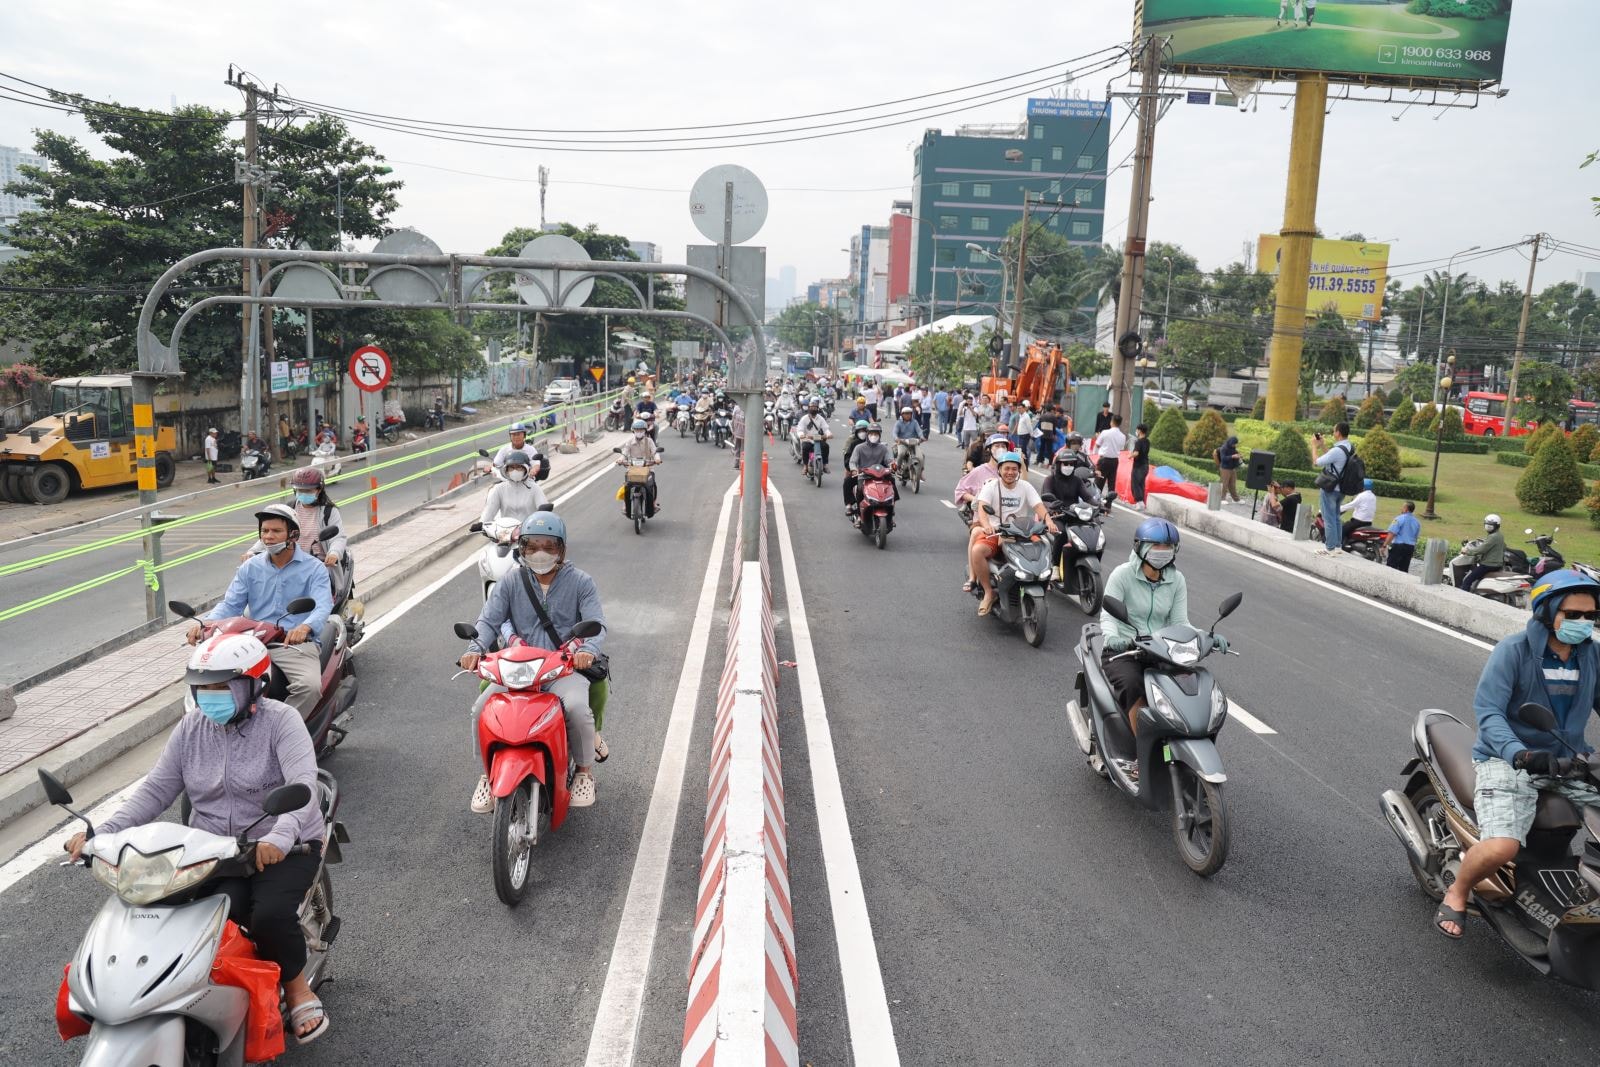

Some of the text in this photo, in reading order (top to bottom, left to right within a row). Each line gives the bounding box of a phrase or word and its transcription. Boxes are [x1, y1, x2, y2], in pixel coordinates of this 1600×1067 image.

[1401, 46, 1491, 61] 1900 633 968
[1401, 57, 1462, 69] kimoanhland.vn
[1309, 276, 1376, 294] 911.39.5555
